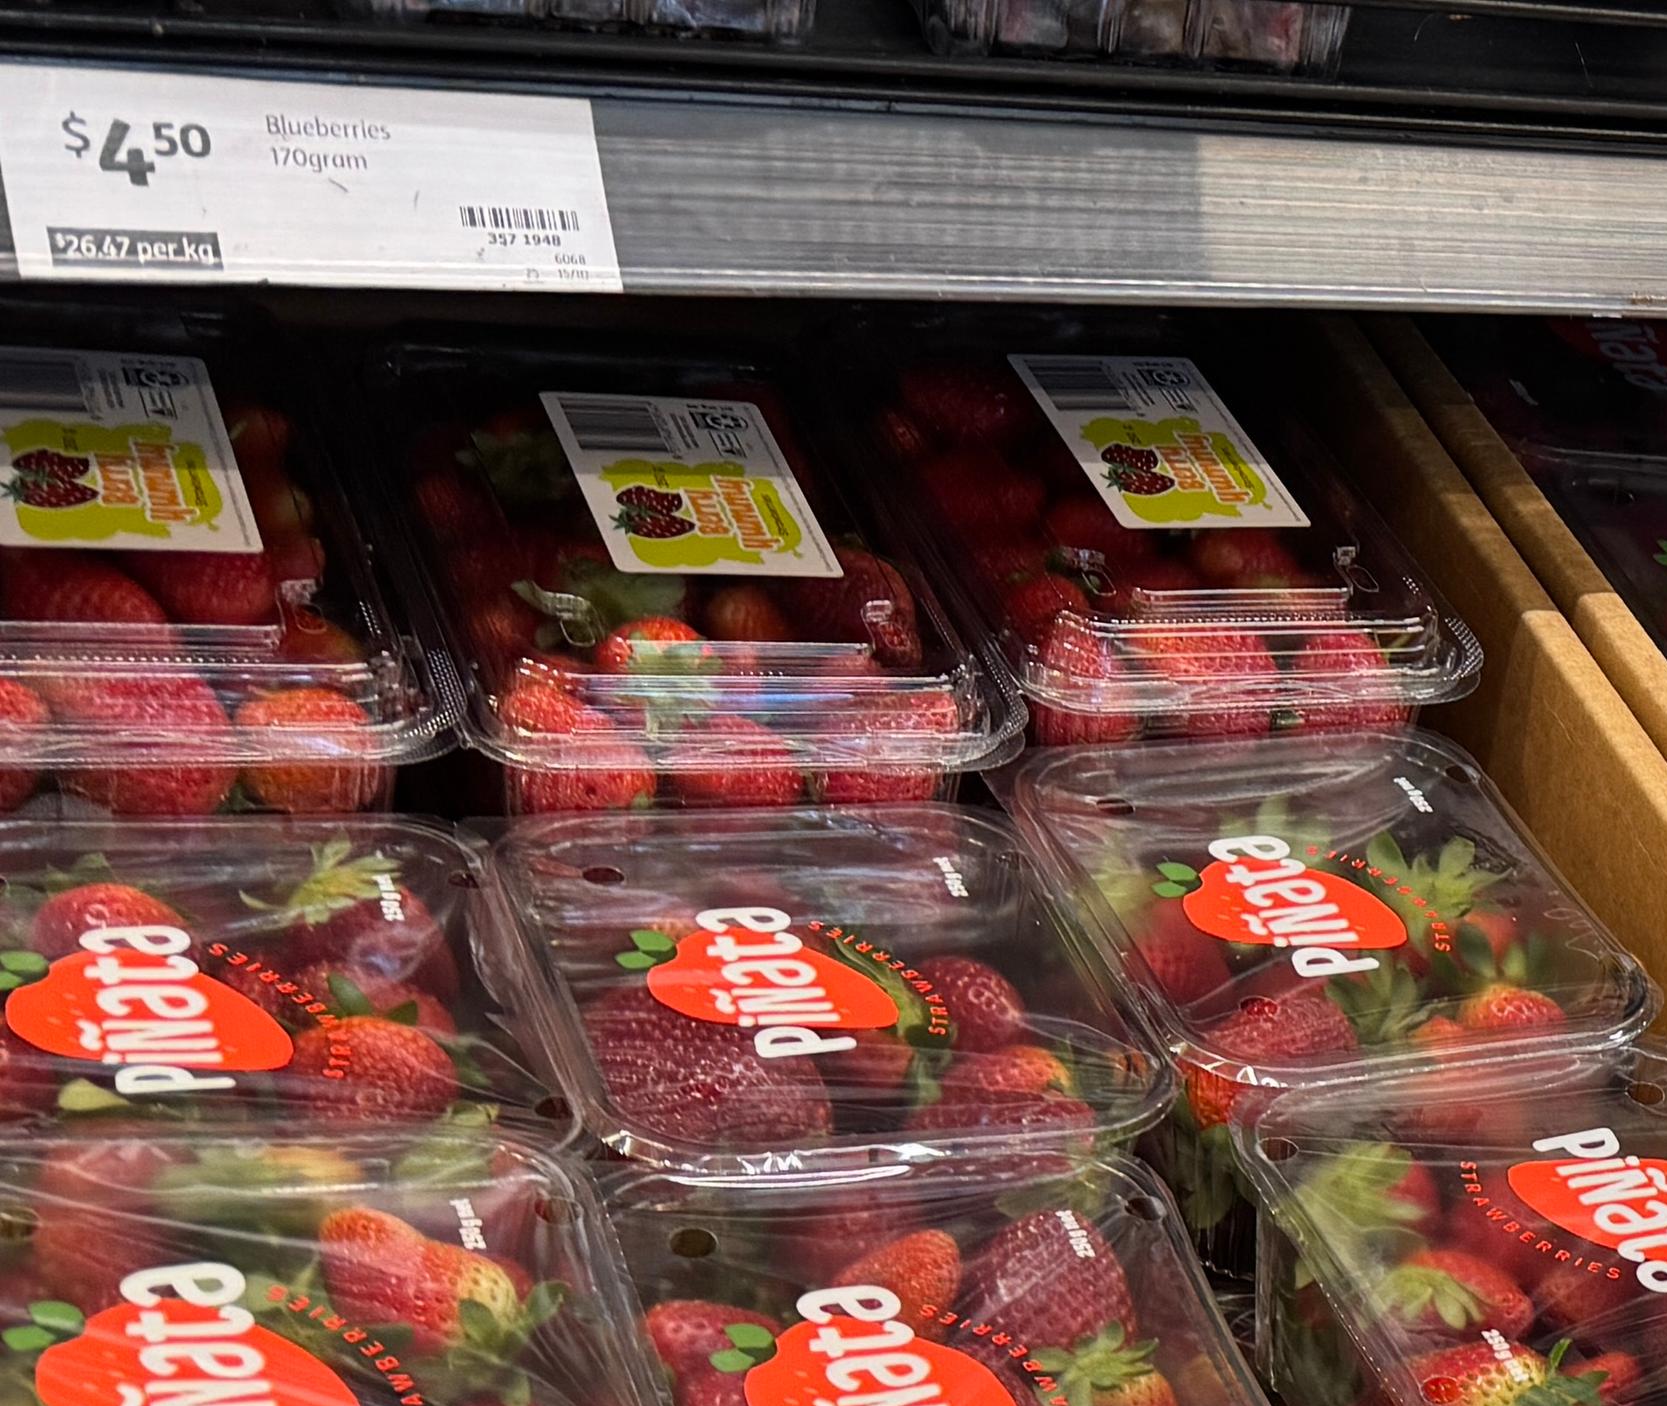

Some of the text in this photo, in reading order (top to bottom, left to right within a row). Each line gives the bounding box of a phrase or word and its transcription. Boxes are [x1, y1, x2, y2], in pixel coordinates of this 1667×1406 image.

[265, 113, 392, 141] Blueberries
[270, 146, 370, 173] 170gram
[54, 232, 216, 264] $26.47 per kg
[523, 232, 562, 247] 1948
[807, 919, 955, 1038] STRAWBERRIES
[1458, 1160, 1625, 1281] STRAWBERRIES
